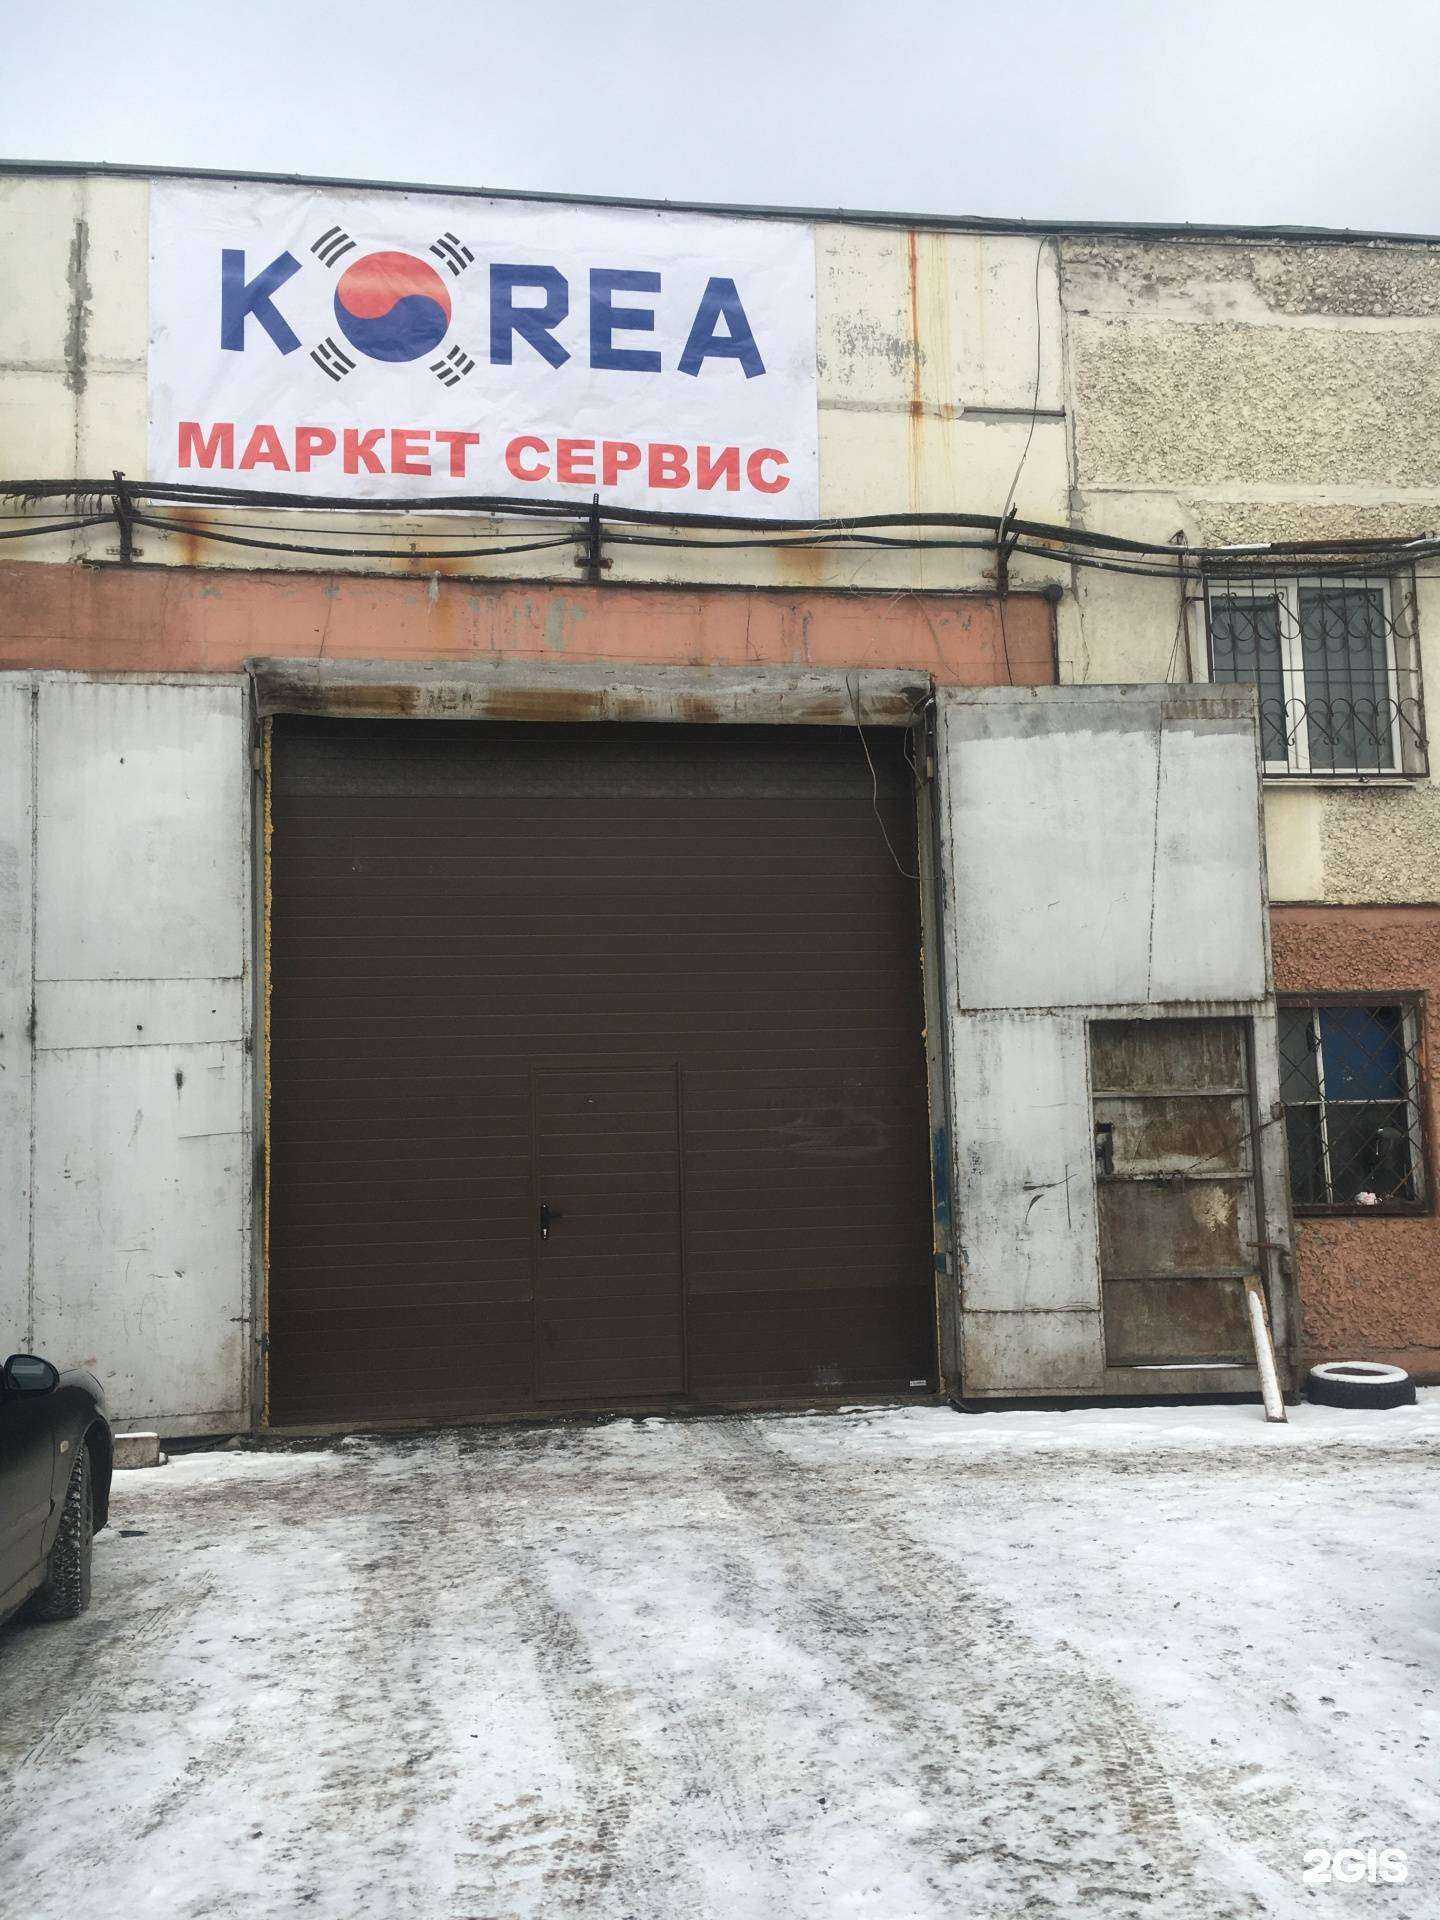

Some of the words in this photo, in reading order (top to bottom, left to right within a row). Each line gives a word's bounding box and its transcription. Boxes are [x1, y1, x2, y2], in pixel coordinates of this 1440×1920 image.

[221, 248, 767, 380] KOREA
[178, 422, 480, 478] МАРКЕТ
[505, 435, 791, 494] СЕРВИС
